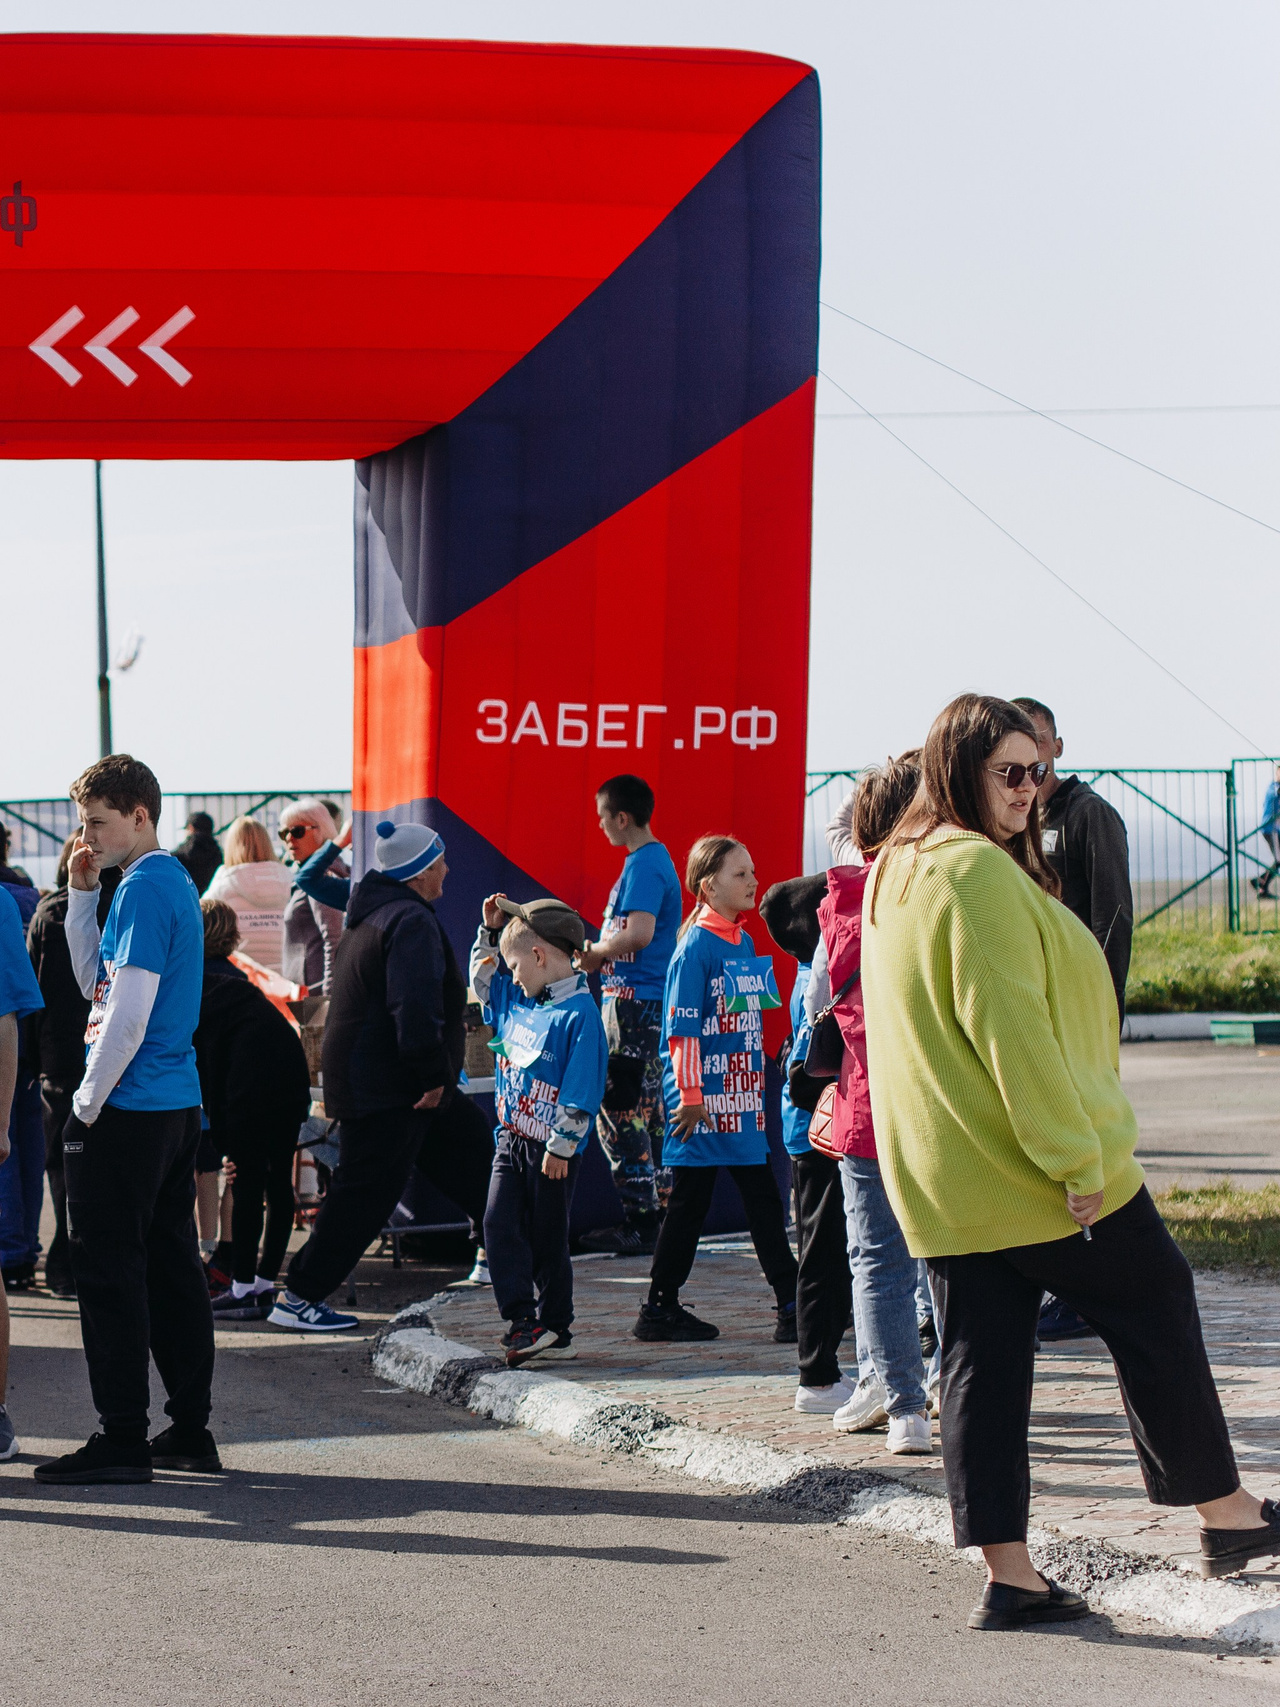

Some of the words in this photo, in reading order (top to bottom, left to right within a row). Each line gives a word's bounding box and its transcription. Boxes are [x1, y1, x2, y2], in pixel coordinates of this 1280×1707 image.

[476, 699, 777, 750] ЗАБЕГ.РФ
[677, 1007, 699, 1018] ПСБ
[704, 1051, 753, 1075] #ЗАБЕГ
